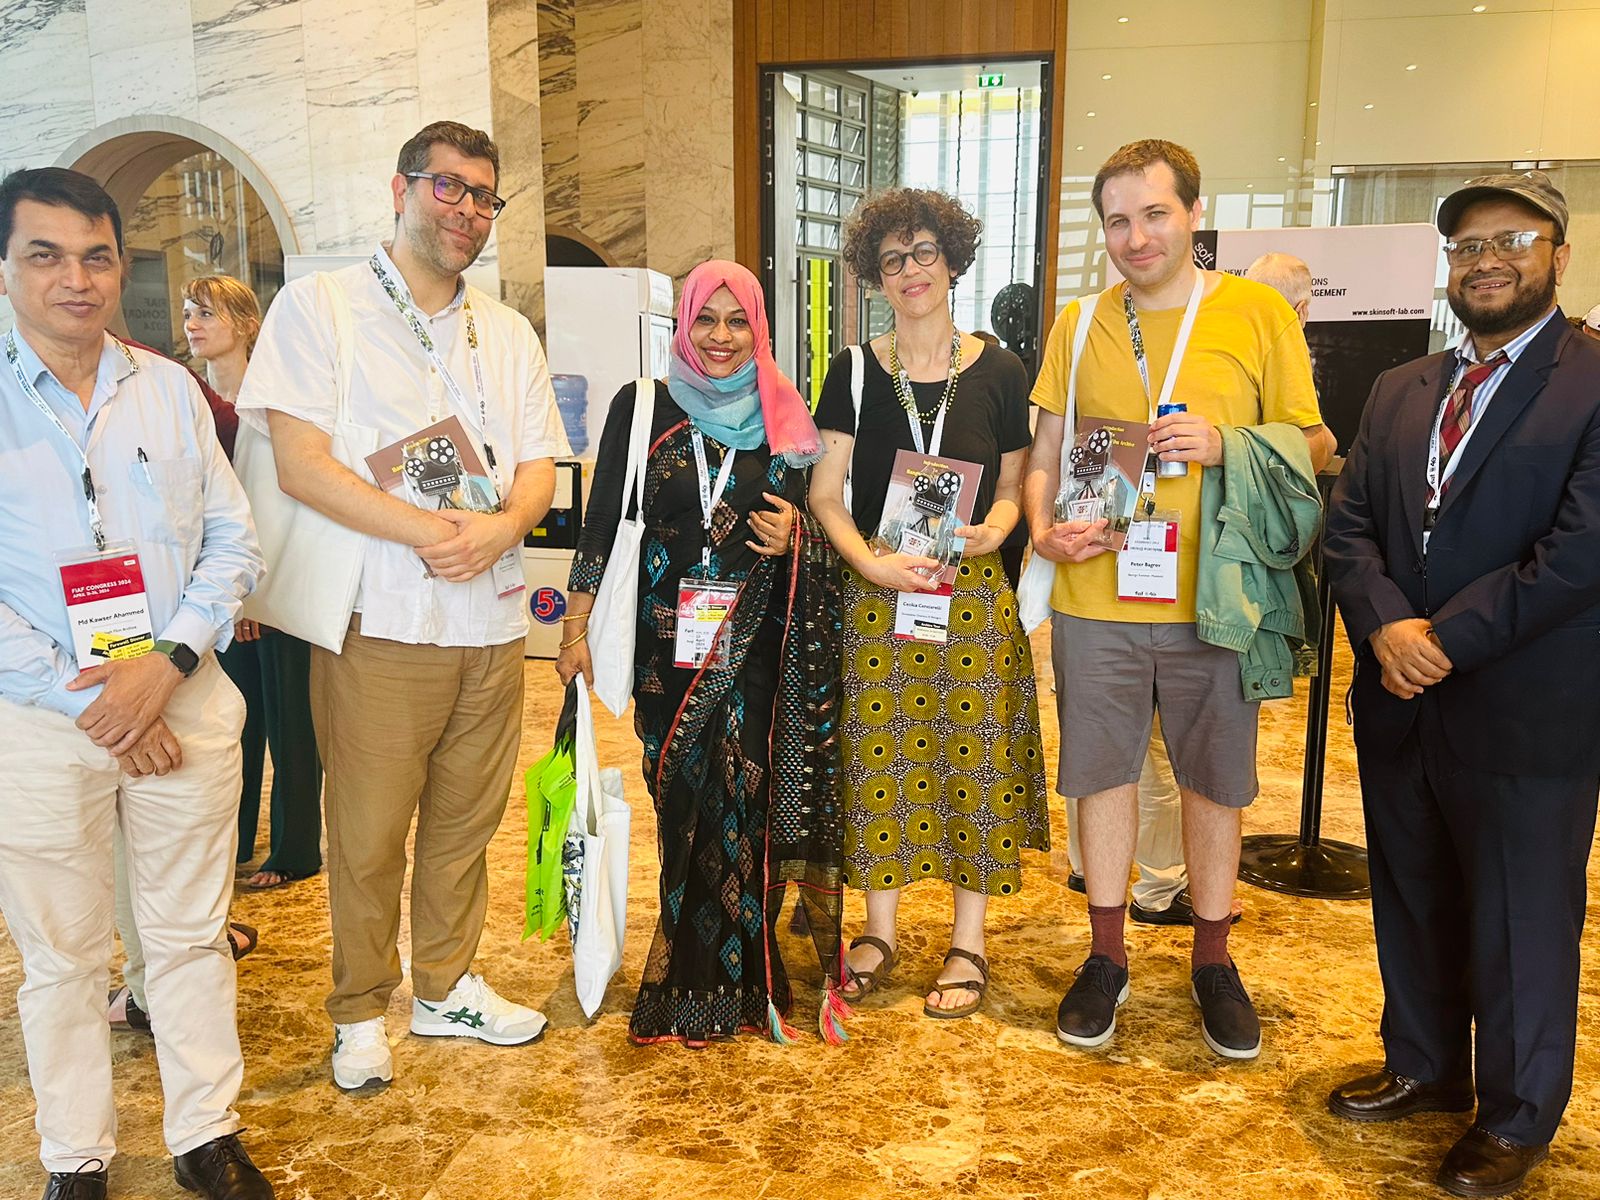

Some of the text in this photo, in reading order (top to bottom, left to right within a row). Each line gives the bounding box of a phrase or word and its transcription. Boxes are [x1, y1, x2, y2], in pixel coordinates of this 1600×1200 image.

[1352, 307, 1425, 316] www.skinsoft-lab.com
[86, 581, 117, 591] CONGRESS
[535, 589, 555, 617] 5
[89, 614, 112, 624] Kawser
[113, 608, 145, 619] Ahammed
